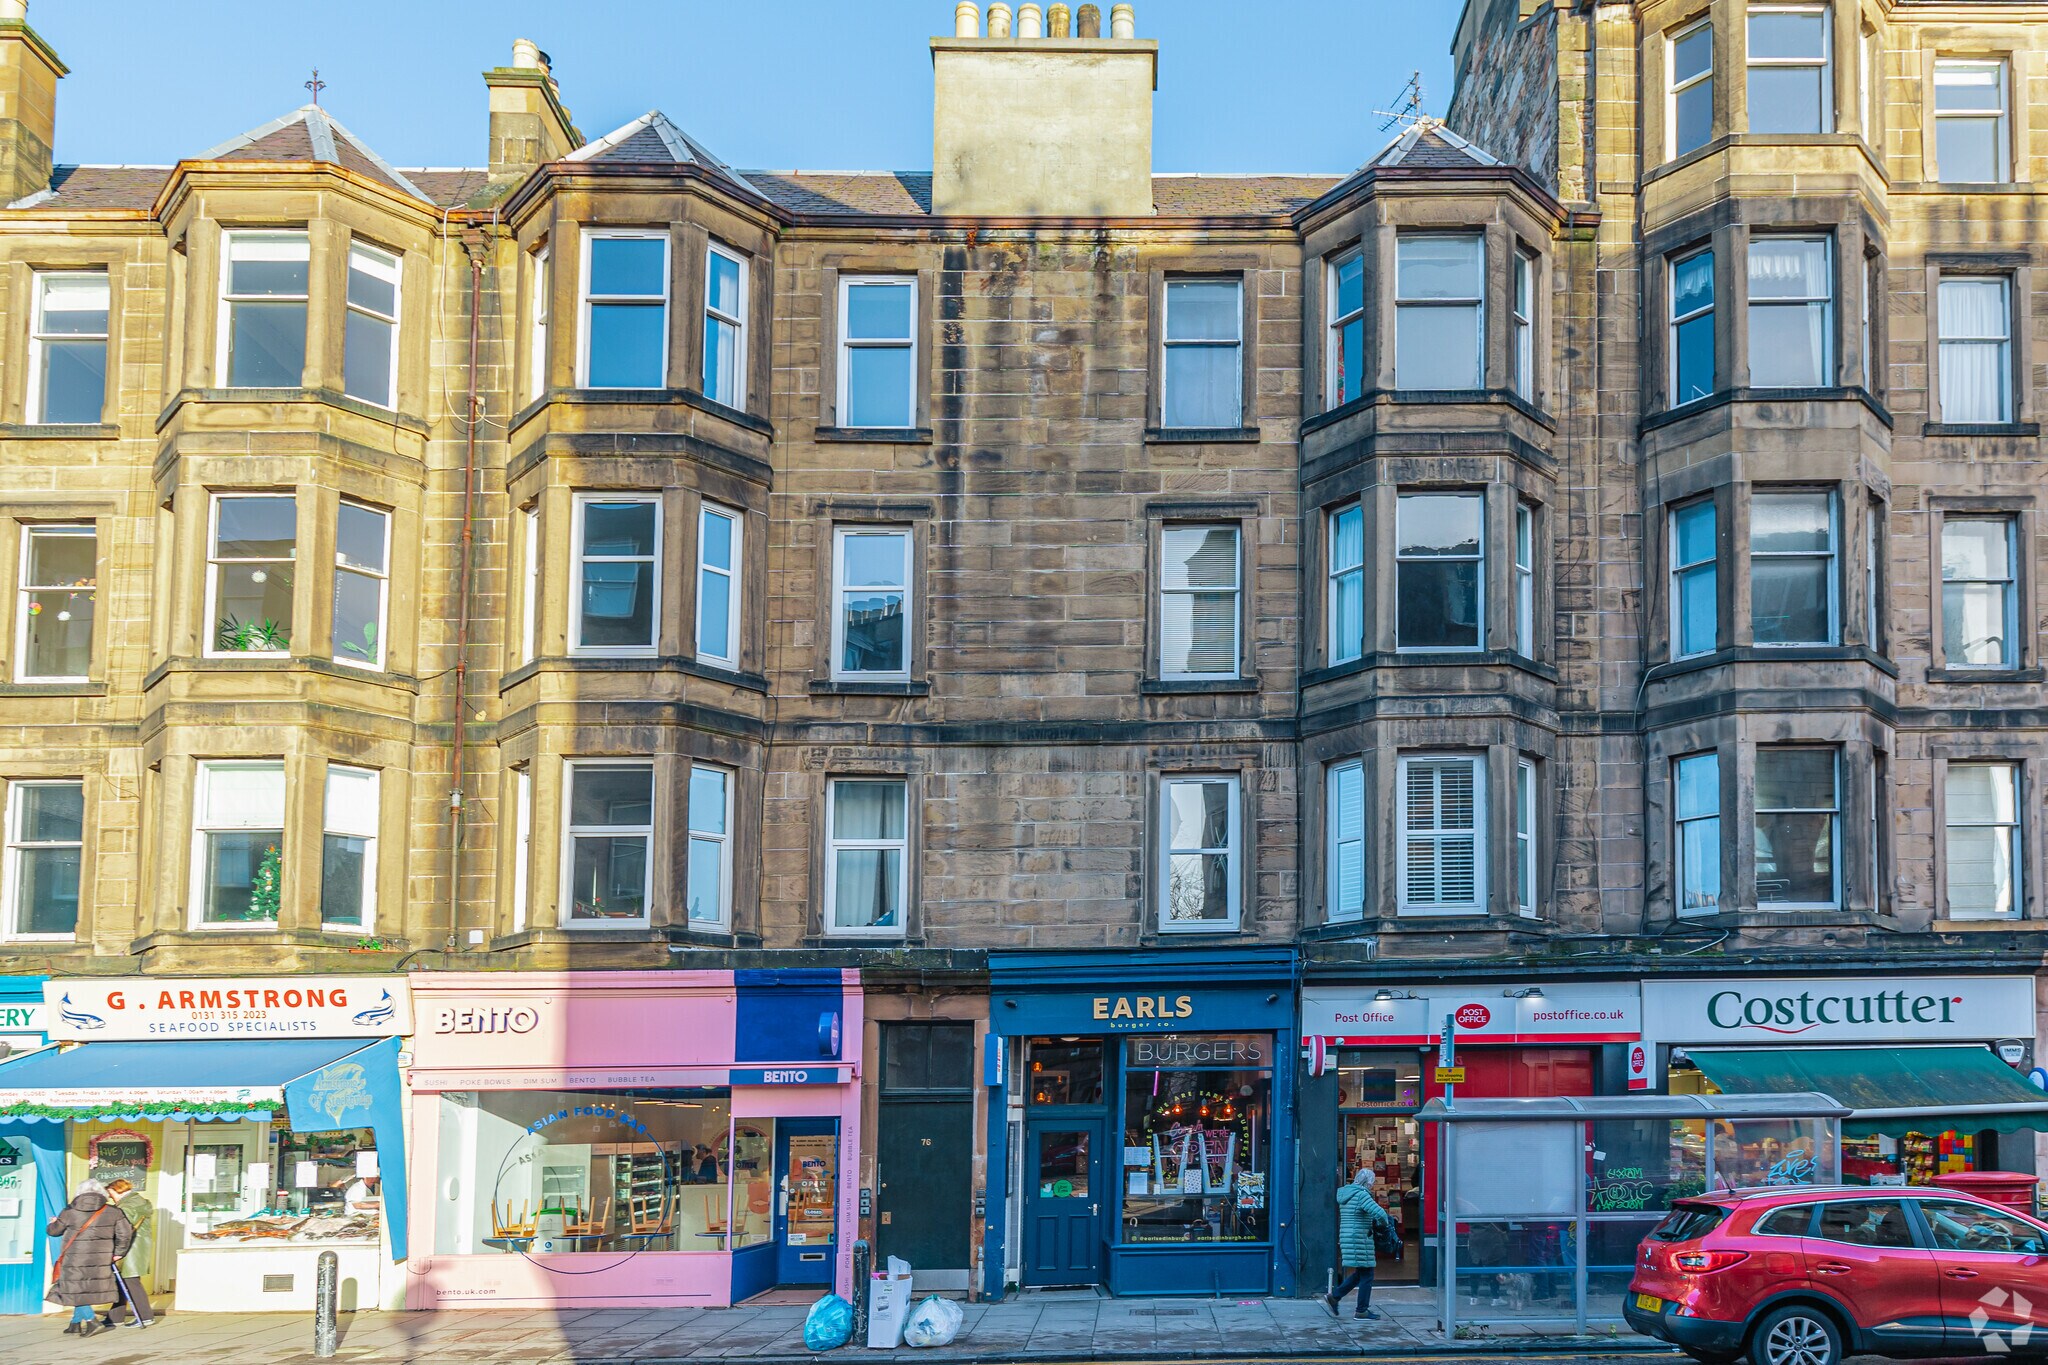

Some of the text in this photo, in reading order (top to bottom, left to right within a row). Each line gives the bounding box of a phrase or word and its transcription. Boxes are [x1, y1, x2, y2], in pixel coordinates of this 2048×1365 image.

[157, 989, 348, 1010] ARMSTRONG
[1093, 995, 1193, 1019] EARLS
[1462, 1008, 1484, 1016] POST
[1706, 989, 1964, 1029] Costcutter
[191, 1010, 267, 1020] 0131 315 2023
[434, 1006, 539, 1034] BENTO
[1335, 1012, 1394, 1023] Post Office
[1457, 1015, 1487, 1023] OFFICE
[1533, 1009, 1624, 1022] postoffice.co.uk
[149, 1021, 317, 1033] SEAFOOD SPECIALISTS
[1138, 1042, 1262, 1061] BURGERS
[424, 1078, 448, 1086] SUSHI
[523, 1077, 538, 1085] DIM
[763, 1070, 808, 1083] BENTO
[1174, 1091, 1193, 1102] ARE
[526, 1107, 647, 1136] ASIAN FOOD BAR
[920, 1138, 932, 1146] 76
[802, 1160, 826, 1168] BENTO
